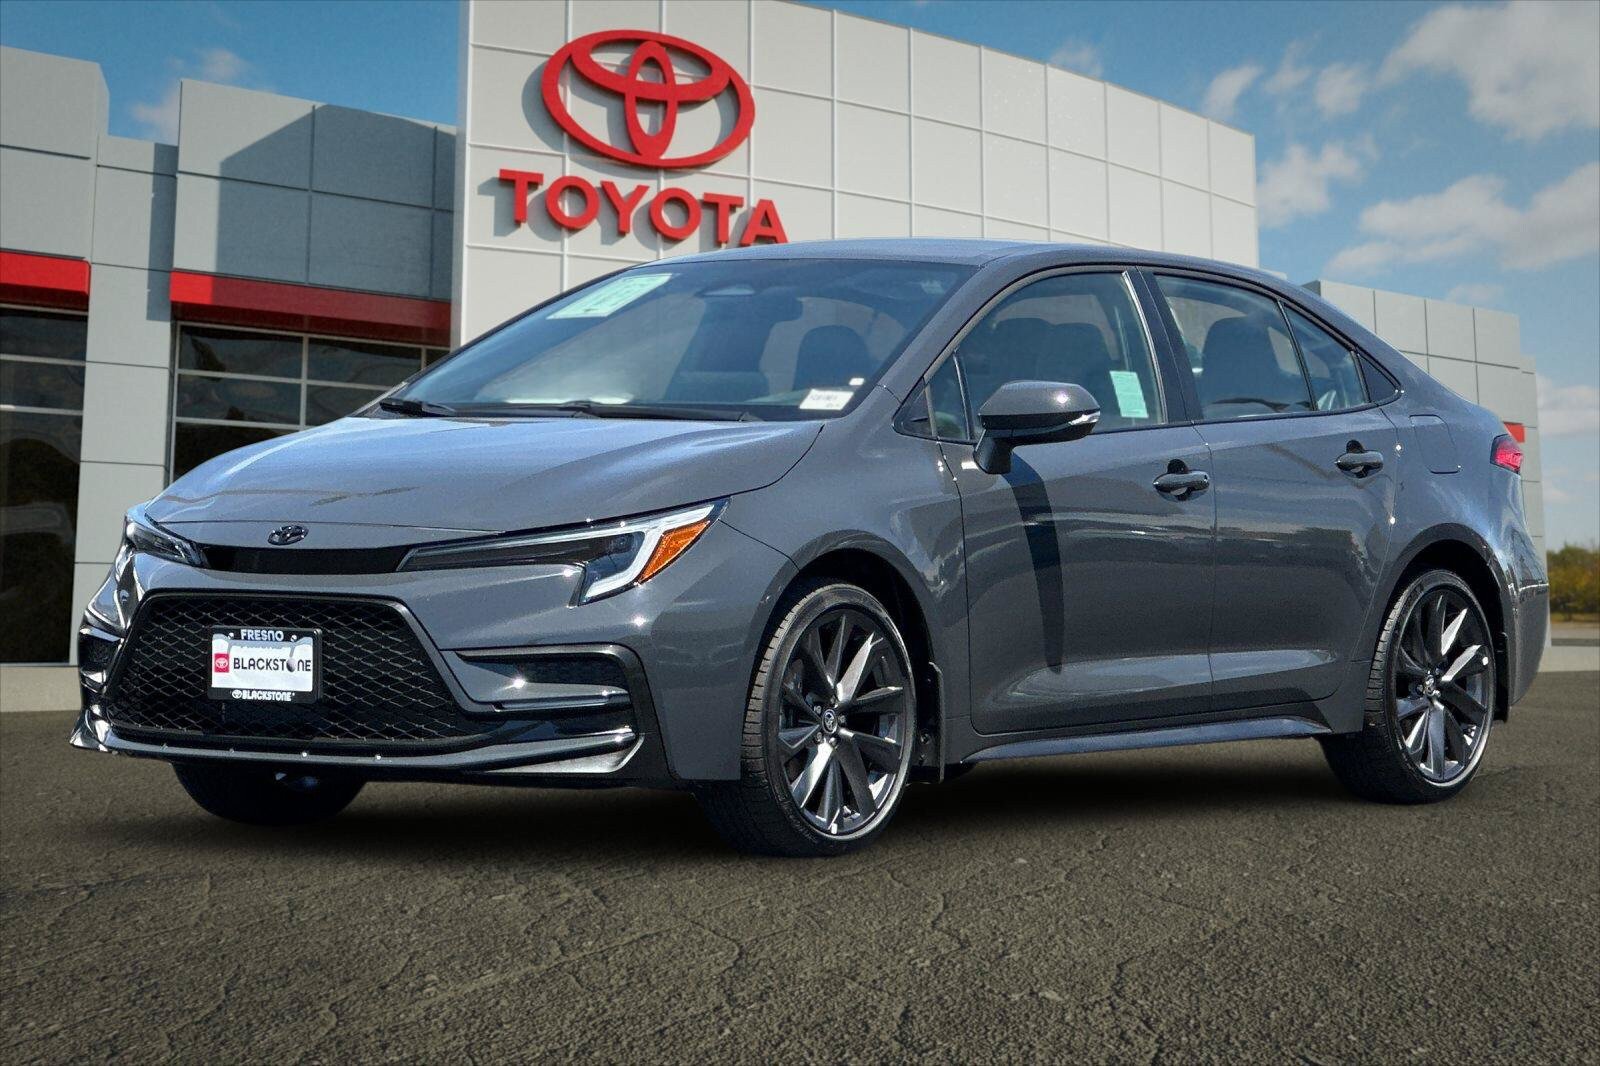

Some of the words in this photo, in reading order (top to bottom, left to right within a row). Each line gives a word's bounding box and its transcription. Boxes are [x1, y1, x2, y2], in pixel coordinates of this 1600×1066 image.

[498, 168, 789, 246] TOYOTA
[240, 629, 284, 641] FRESNO
[233, 657, 311, 673] BLACKSTONE
[242, 690, 292, 701] BLACKSTONE
